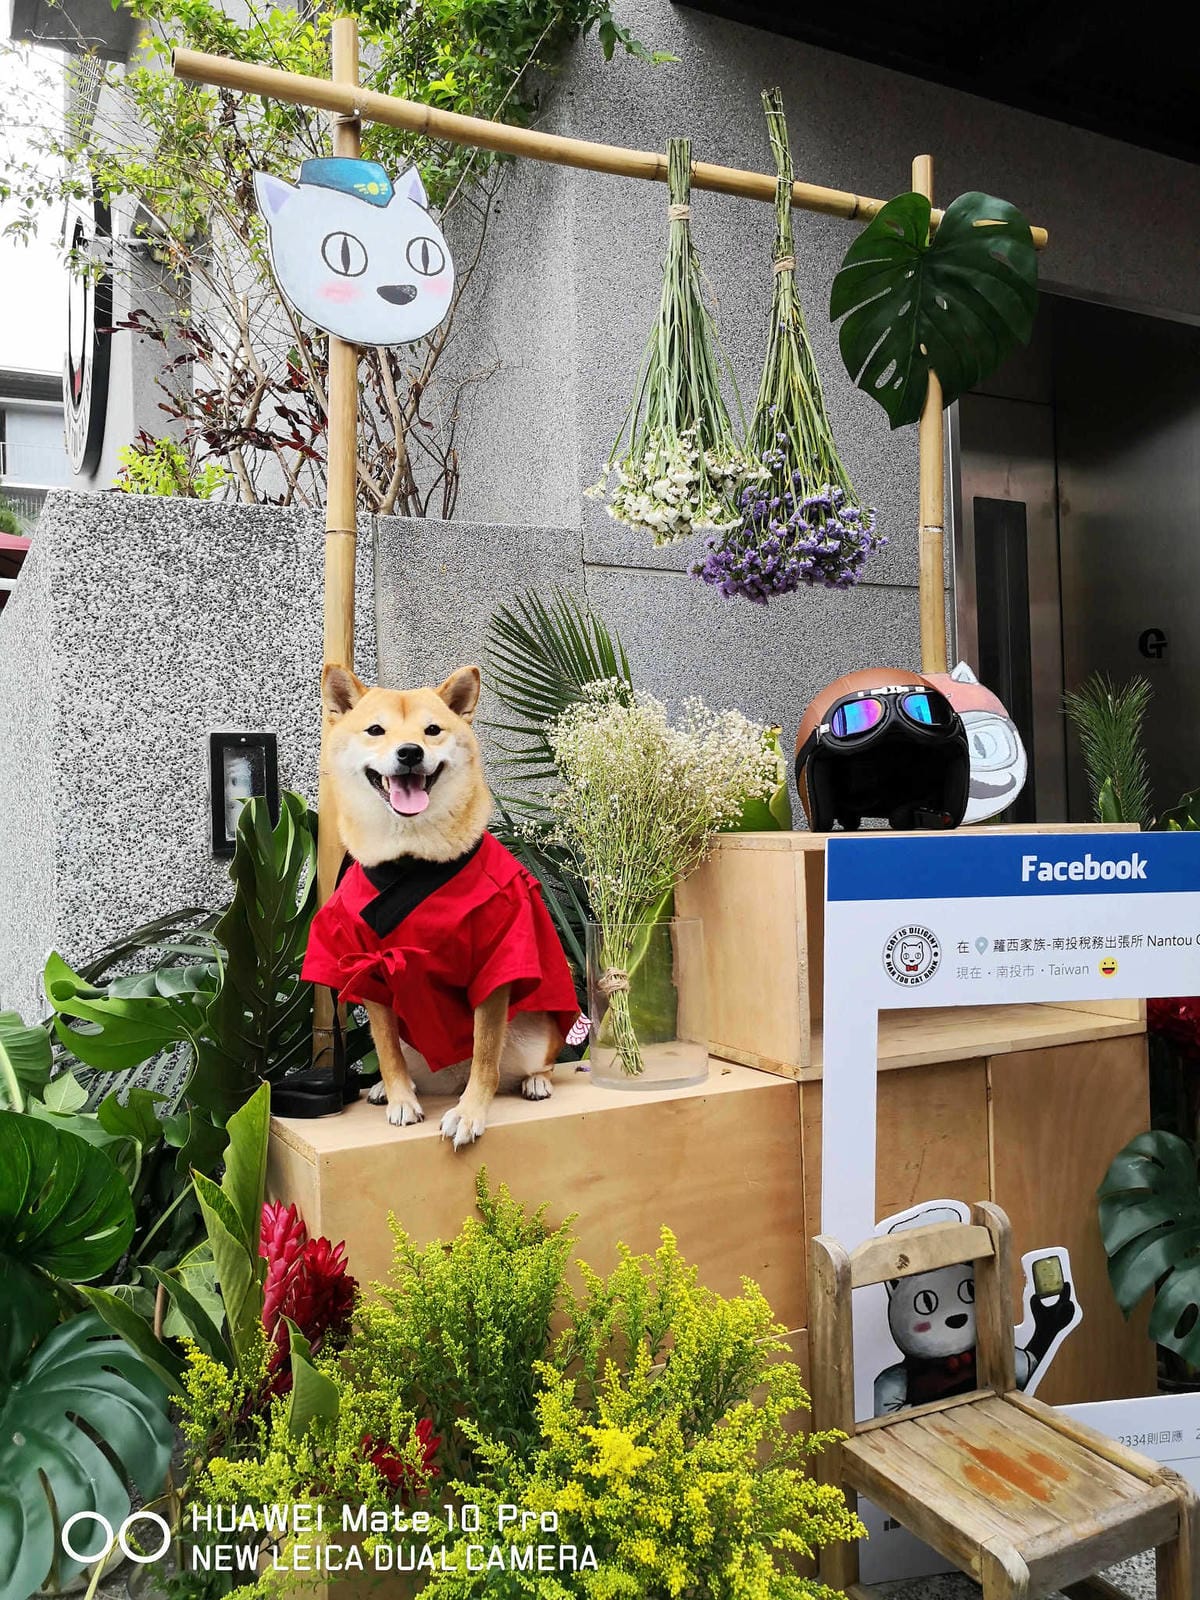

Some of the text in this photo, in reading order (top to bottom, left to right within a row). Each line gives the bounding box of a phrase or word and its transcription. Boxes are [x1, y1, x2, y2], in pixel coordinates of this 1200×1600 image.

[1021, 852, 1148, 882] Facebook
[886, 927, 939, 951] CAT IS DILIGENT
[956, 939, 970, 954] 在
[1147, 935, 1193, 947] Nantou
[886, 960, 939, 984] NAN TOU CAT BANK
[956, 963, 1090, 980] 現在 南投市 Taiwan
